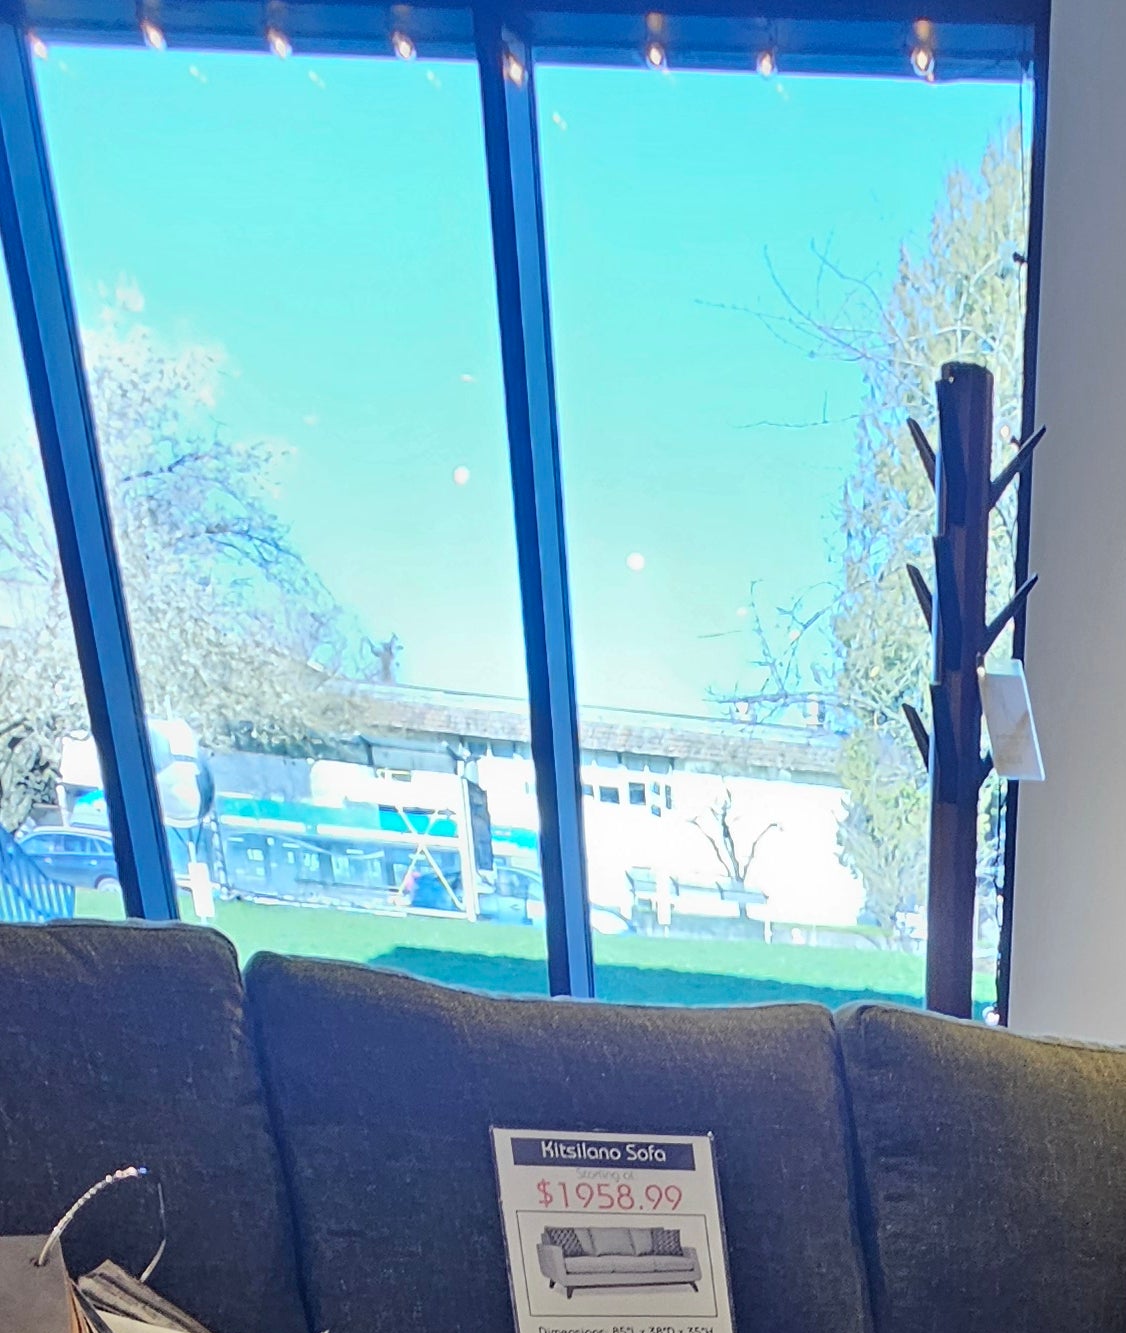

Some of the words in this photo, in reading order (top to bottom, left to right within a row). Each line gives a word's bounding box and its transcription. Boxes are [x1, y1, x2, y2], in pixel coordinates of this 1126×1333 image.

[541, 1140, 621, 1161] Kitsilano
[625, 1143, 667, 1163] Sofa
[536, 1178, 683, 1211] $1958.99
